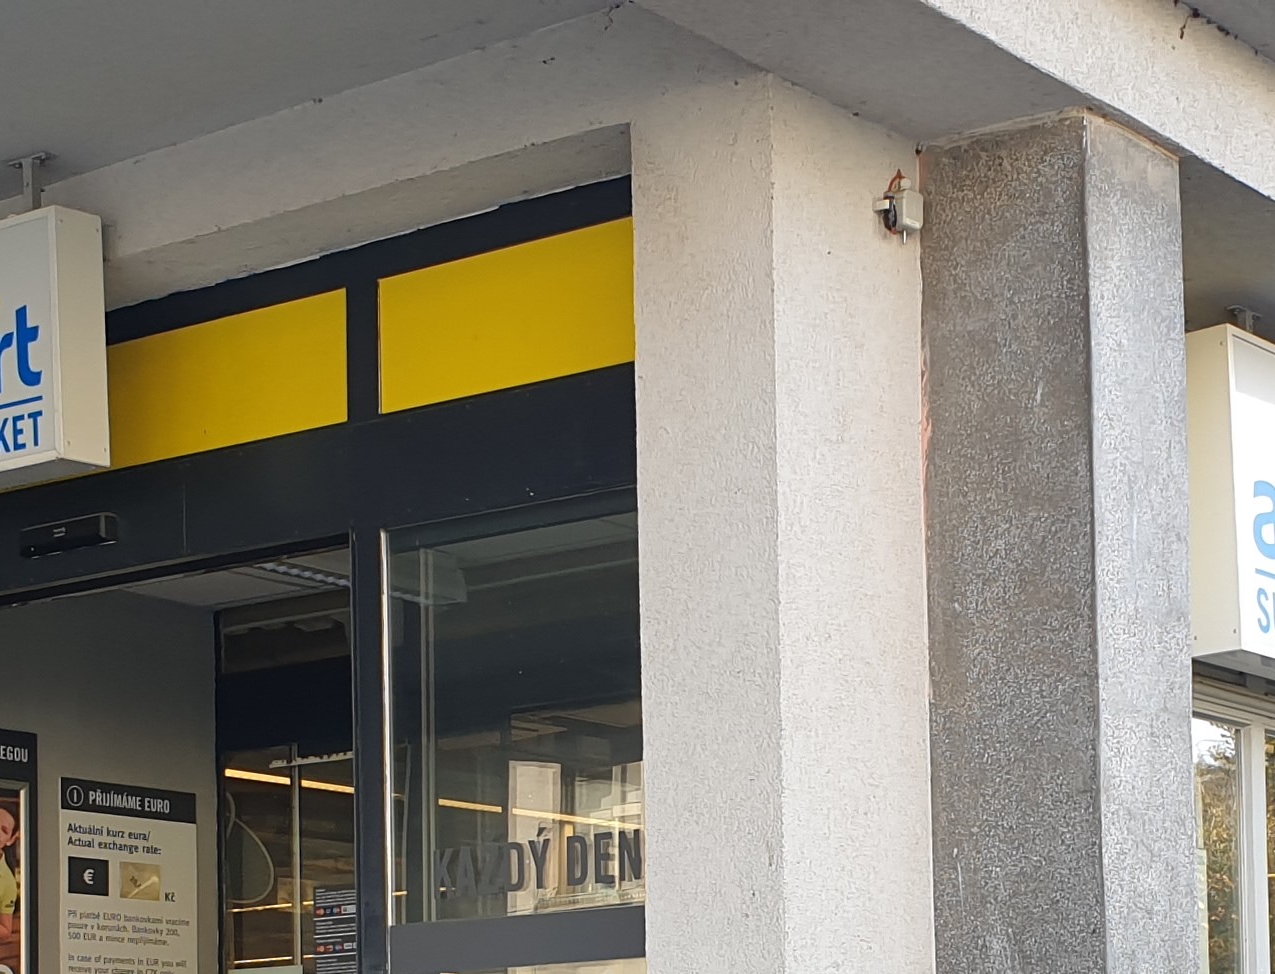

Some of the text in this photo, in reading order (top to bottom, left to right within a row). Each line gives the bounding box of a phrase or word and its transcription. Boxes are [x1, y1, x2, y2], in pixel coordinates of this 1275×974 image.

[89, 788, 171, 814] PŘIJÍMÁME EURO
[67, 822, 151, 842] Aktuální kurz eura/
[67, 836, 162, 855] Actual exchange rate:
[566, 828, 642, 887] DEN
[83, 868, 96, 885] €
[164, 892, 176, 902] Kč
